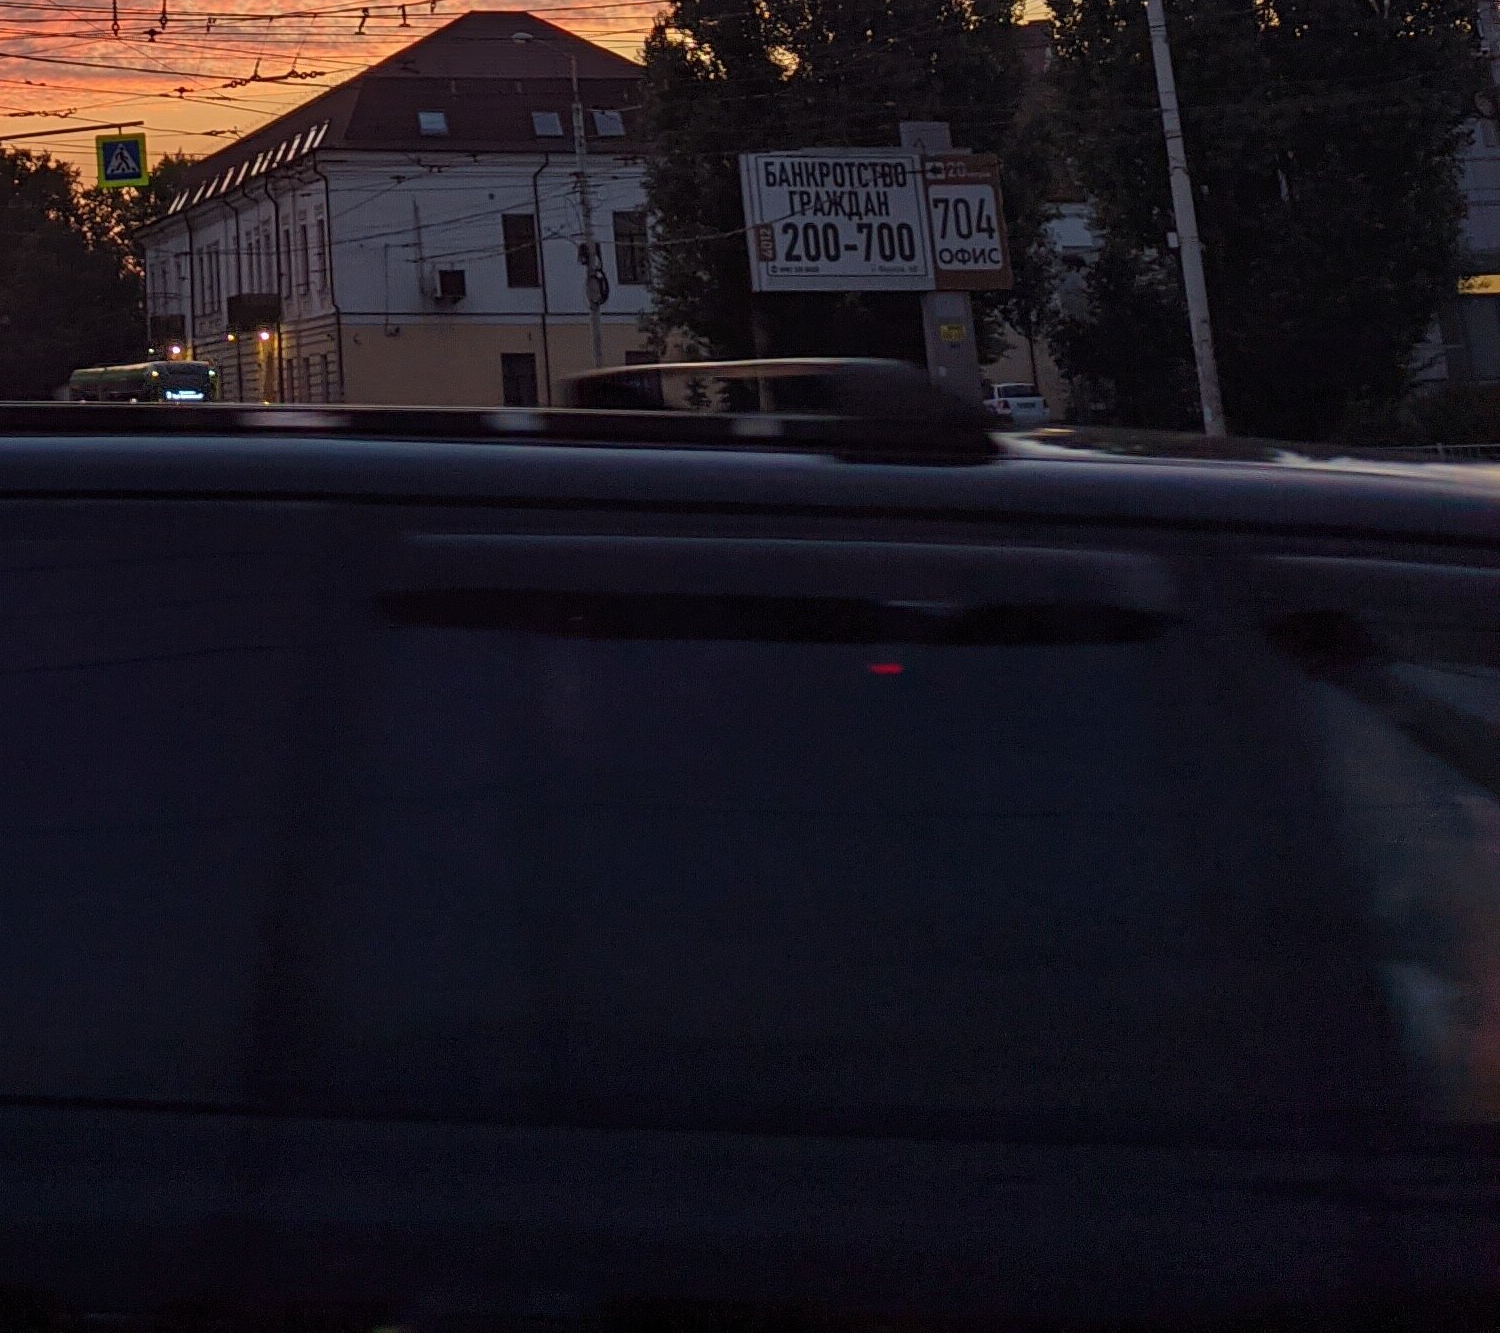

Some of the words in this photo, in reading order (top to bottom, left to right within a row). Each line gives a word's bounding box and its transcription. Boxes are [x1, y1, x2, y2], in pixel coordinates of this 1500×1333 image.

[763, 161, 908, 188] БАНКРОТСТВО
[788, 190, 890, 220] ГРАЖДАН
[933, 197, 995, 239] 704
[781, 222, 917, 263] 200-700
[939, 247, 1000, 265] ОФИС
